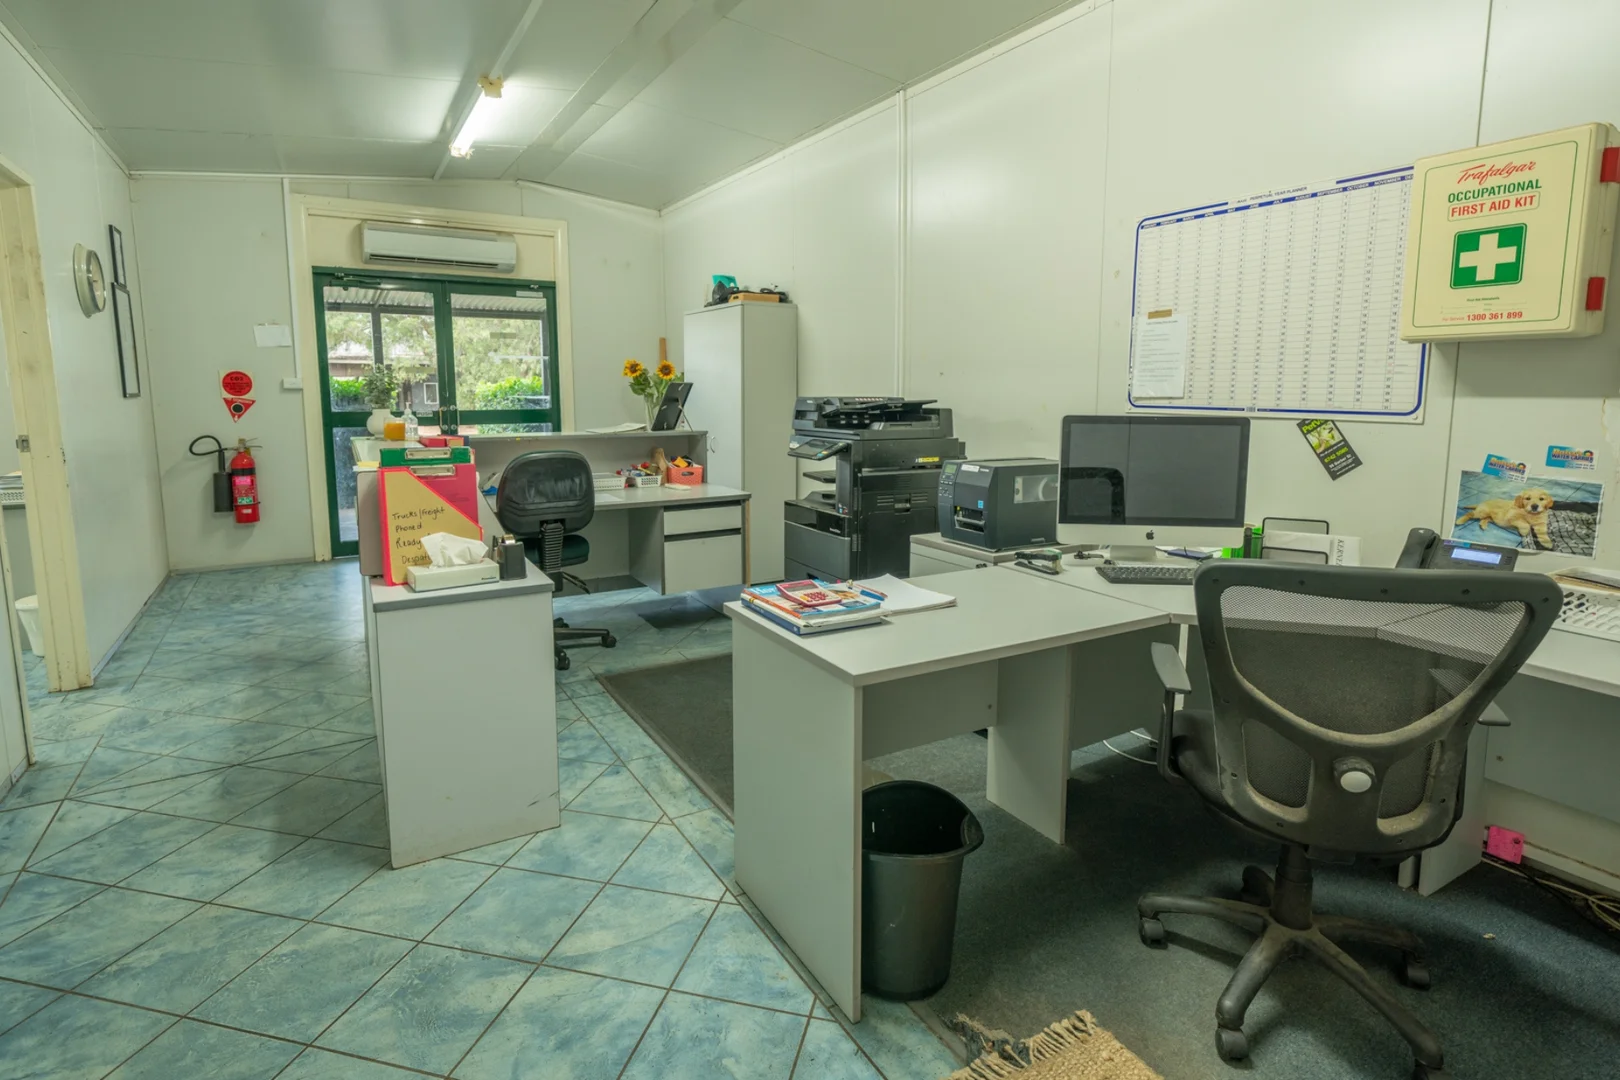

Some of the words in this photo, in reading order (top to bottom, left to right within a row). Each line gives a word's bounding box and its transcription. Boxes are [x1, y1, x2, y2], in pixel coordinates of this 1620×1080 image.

[1457, 161, 1536, 185] Trafalgar
[1346, 183, 1369, 191] OCTOBER
[1374, 177, 1401, 186] NOVEMBER
[1448, 179, 1542, 203] OCCUPATIONAL
[1451, 203, 1486, 217] FIRST
[1489, 199, 1511, 212] AID
[1515, 195, 1536, 208] KIT
[1467, 313, 1487, 321] 1300
[1488, 312, 1504, 320] 361
[1507, 311, 1523, 319] 899
[396, 537, 422, 550] Ready
